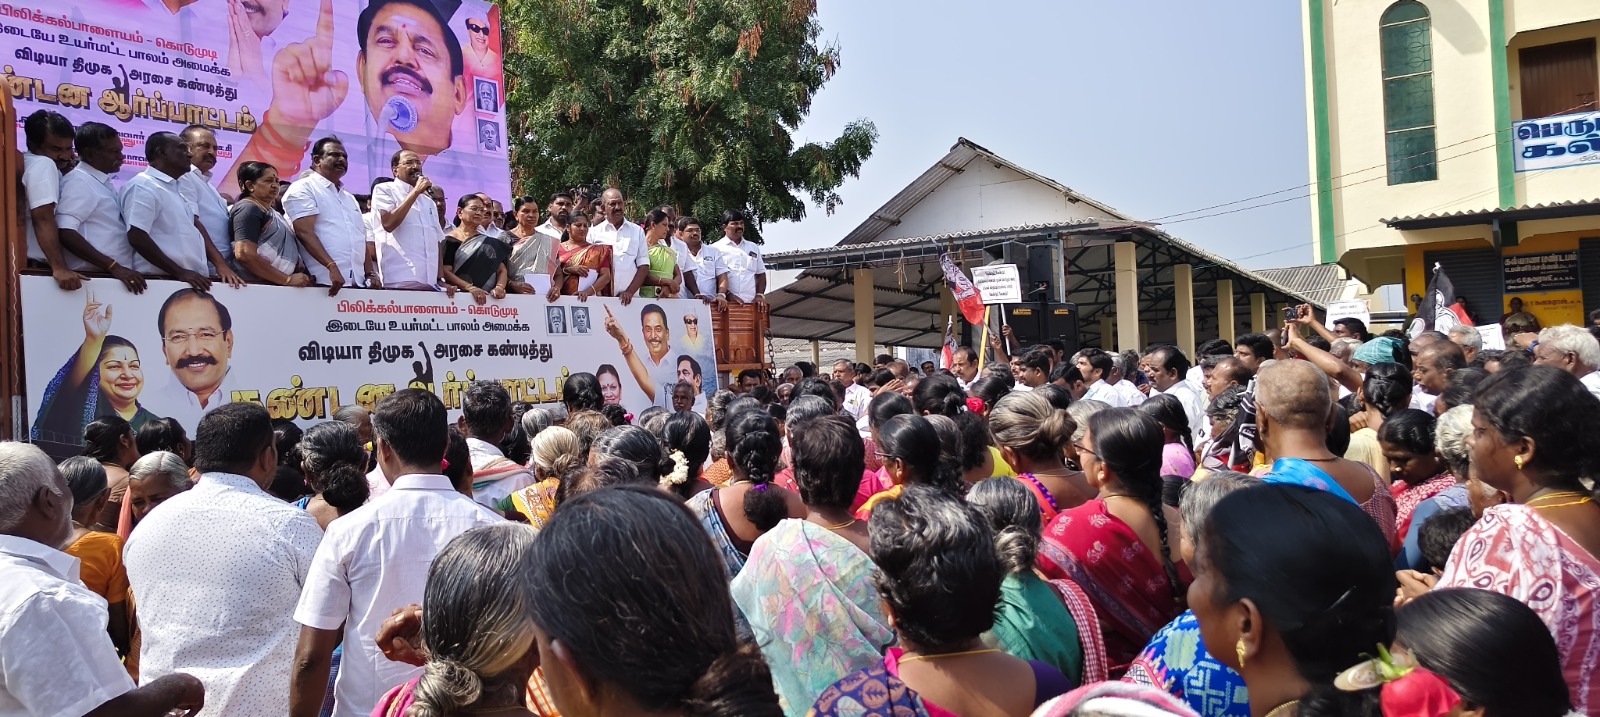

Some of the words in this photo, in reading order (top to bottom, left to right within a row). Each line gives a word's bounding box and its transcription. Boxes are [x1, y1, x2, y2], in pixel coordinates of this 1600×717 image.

[58, 34, 126, 56] உயர்மட்ட
[129, 50, 169, 65] பாலம்
[172, 57, 231, 77] அமைக்க
[156, 37, 218, 61] கொடுமுடி
[15, 47, 68, 67] விடியா
[72, 57, 112, 75] திமுக
[129, 69, 173, 85] அரசை
[177, 78, 238, 101] கண்டித்து
[98, 87, 257, 134] ஆர்ப்பாட்டம்
[337, 299, 458, 315] பிலிக்கல்பாளையம்
[468, 304, 519, 318] கொடுமுடி
[326, 319, 386, 333] இடையே
[388, 318, 445, 332] உயர்மட்ட
[446, 319, 480, 332] பாலம்
[482, 319, 530, 332] அமைக்க
[298, 340, 363, 364] விடியா
[368, 340, 414, 365] திமுக
[434, 343, 483, 362] அரசை
[487, 339, 553, 362] கண்டித்து
